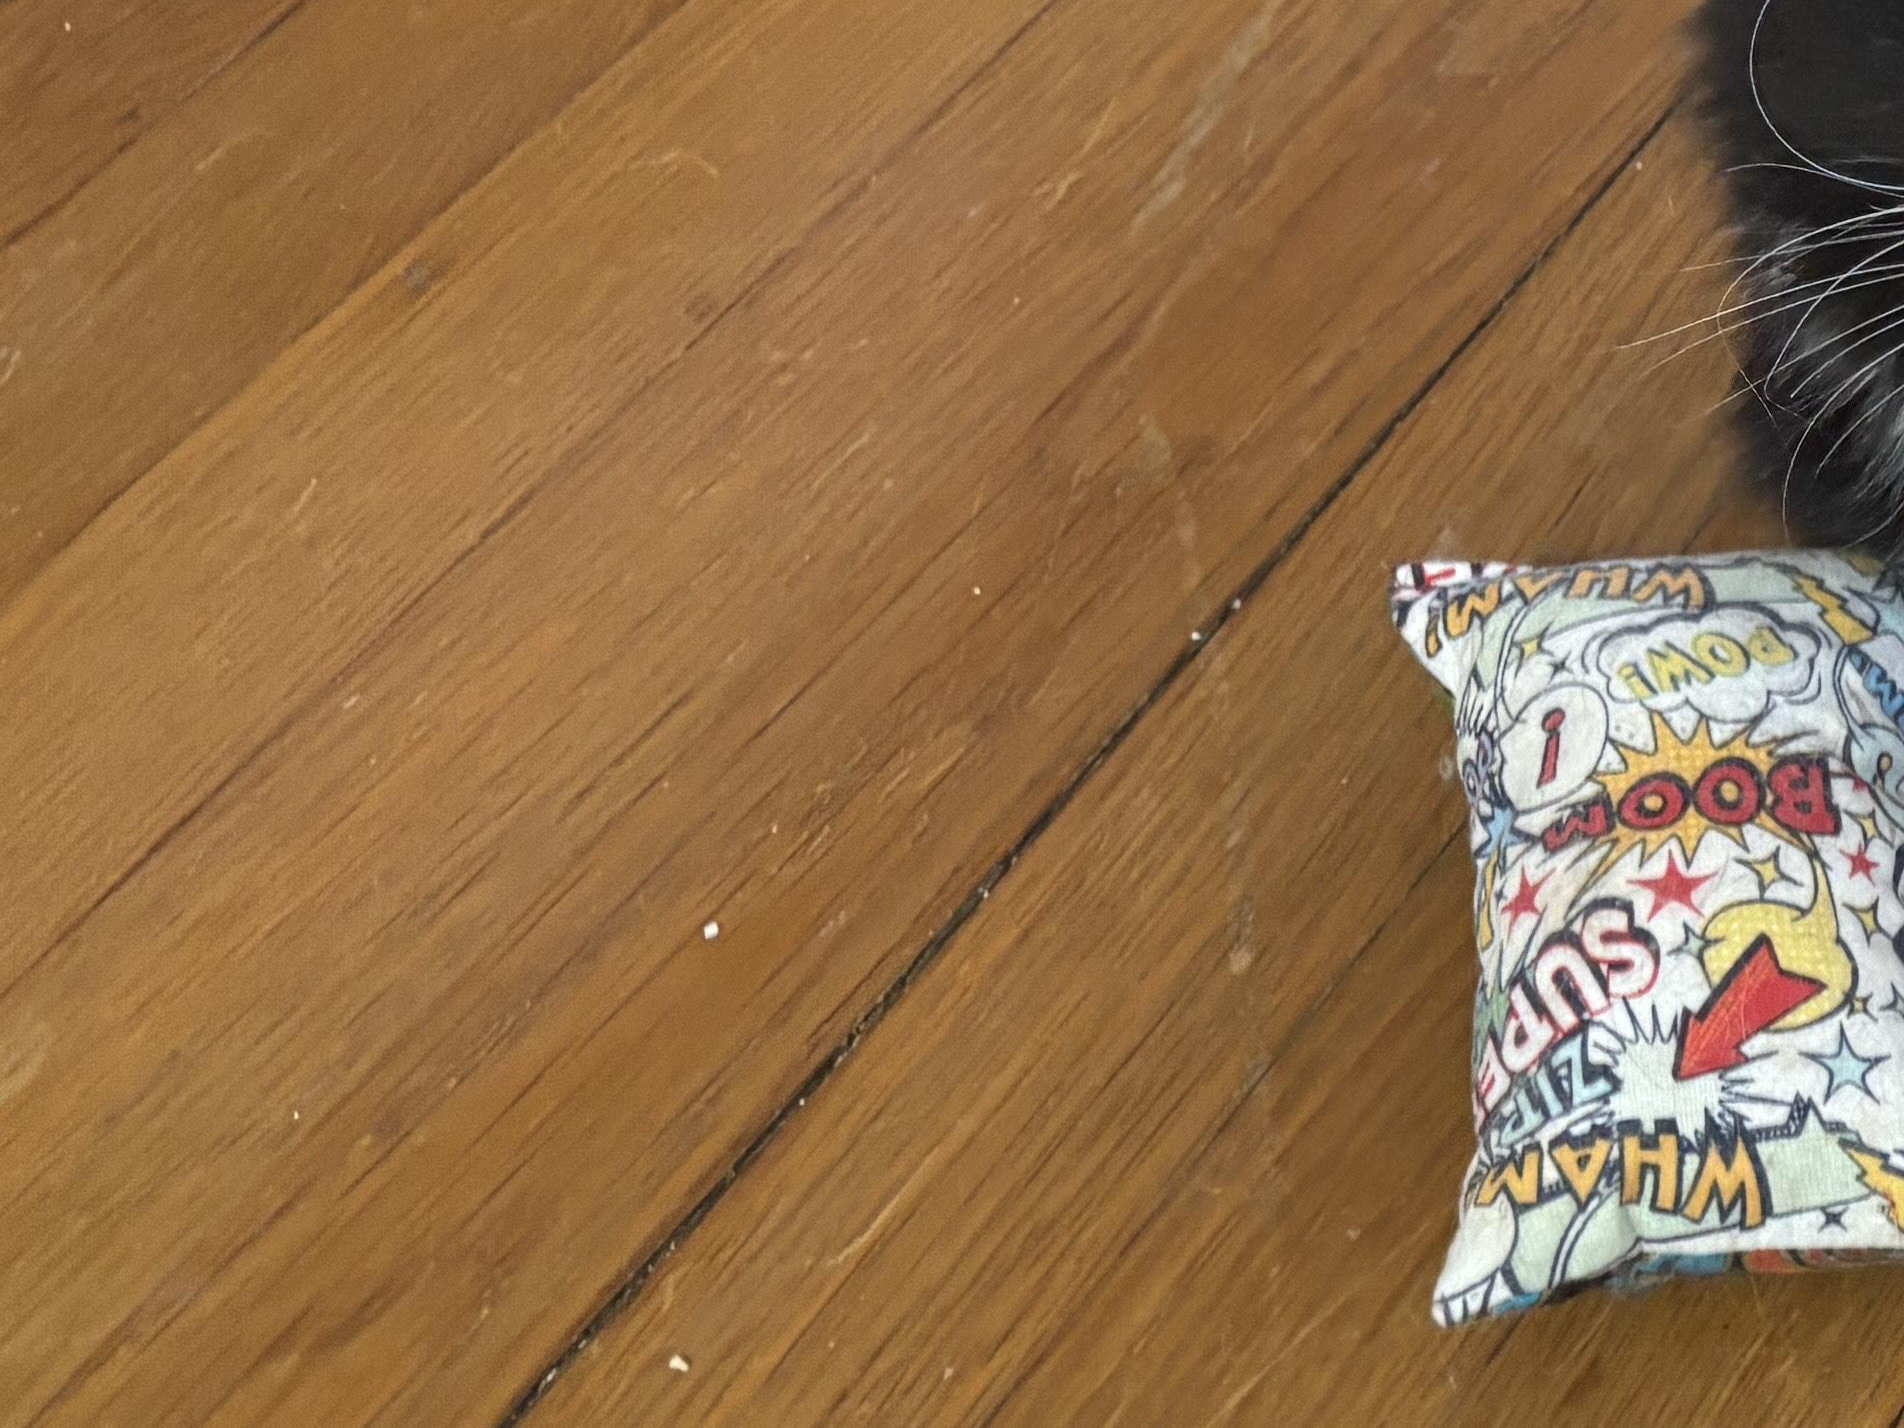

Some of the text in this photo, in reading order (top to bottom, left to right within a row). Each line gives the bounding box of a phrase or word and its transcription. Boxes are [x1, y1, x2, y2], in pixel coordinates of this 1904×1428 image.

[1617, 626, 1799, 701] POW!
[1541, 754, 1842, 853] BOOM
[1472, 897, 1661, 1128] SUPE
[1500, 1025, 1622, 1148] ZIP
[1474, 1118, 1773, 1232] WHAM
